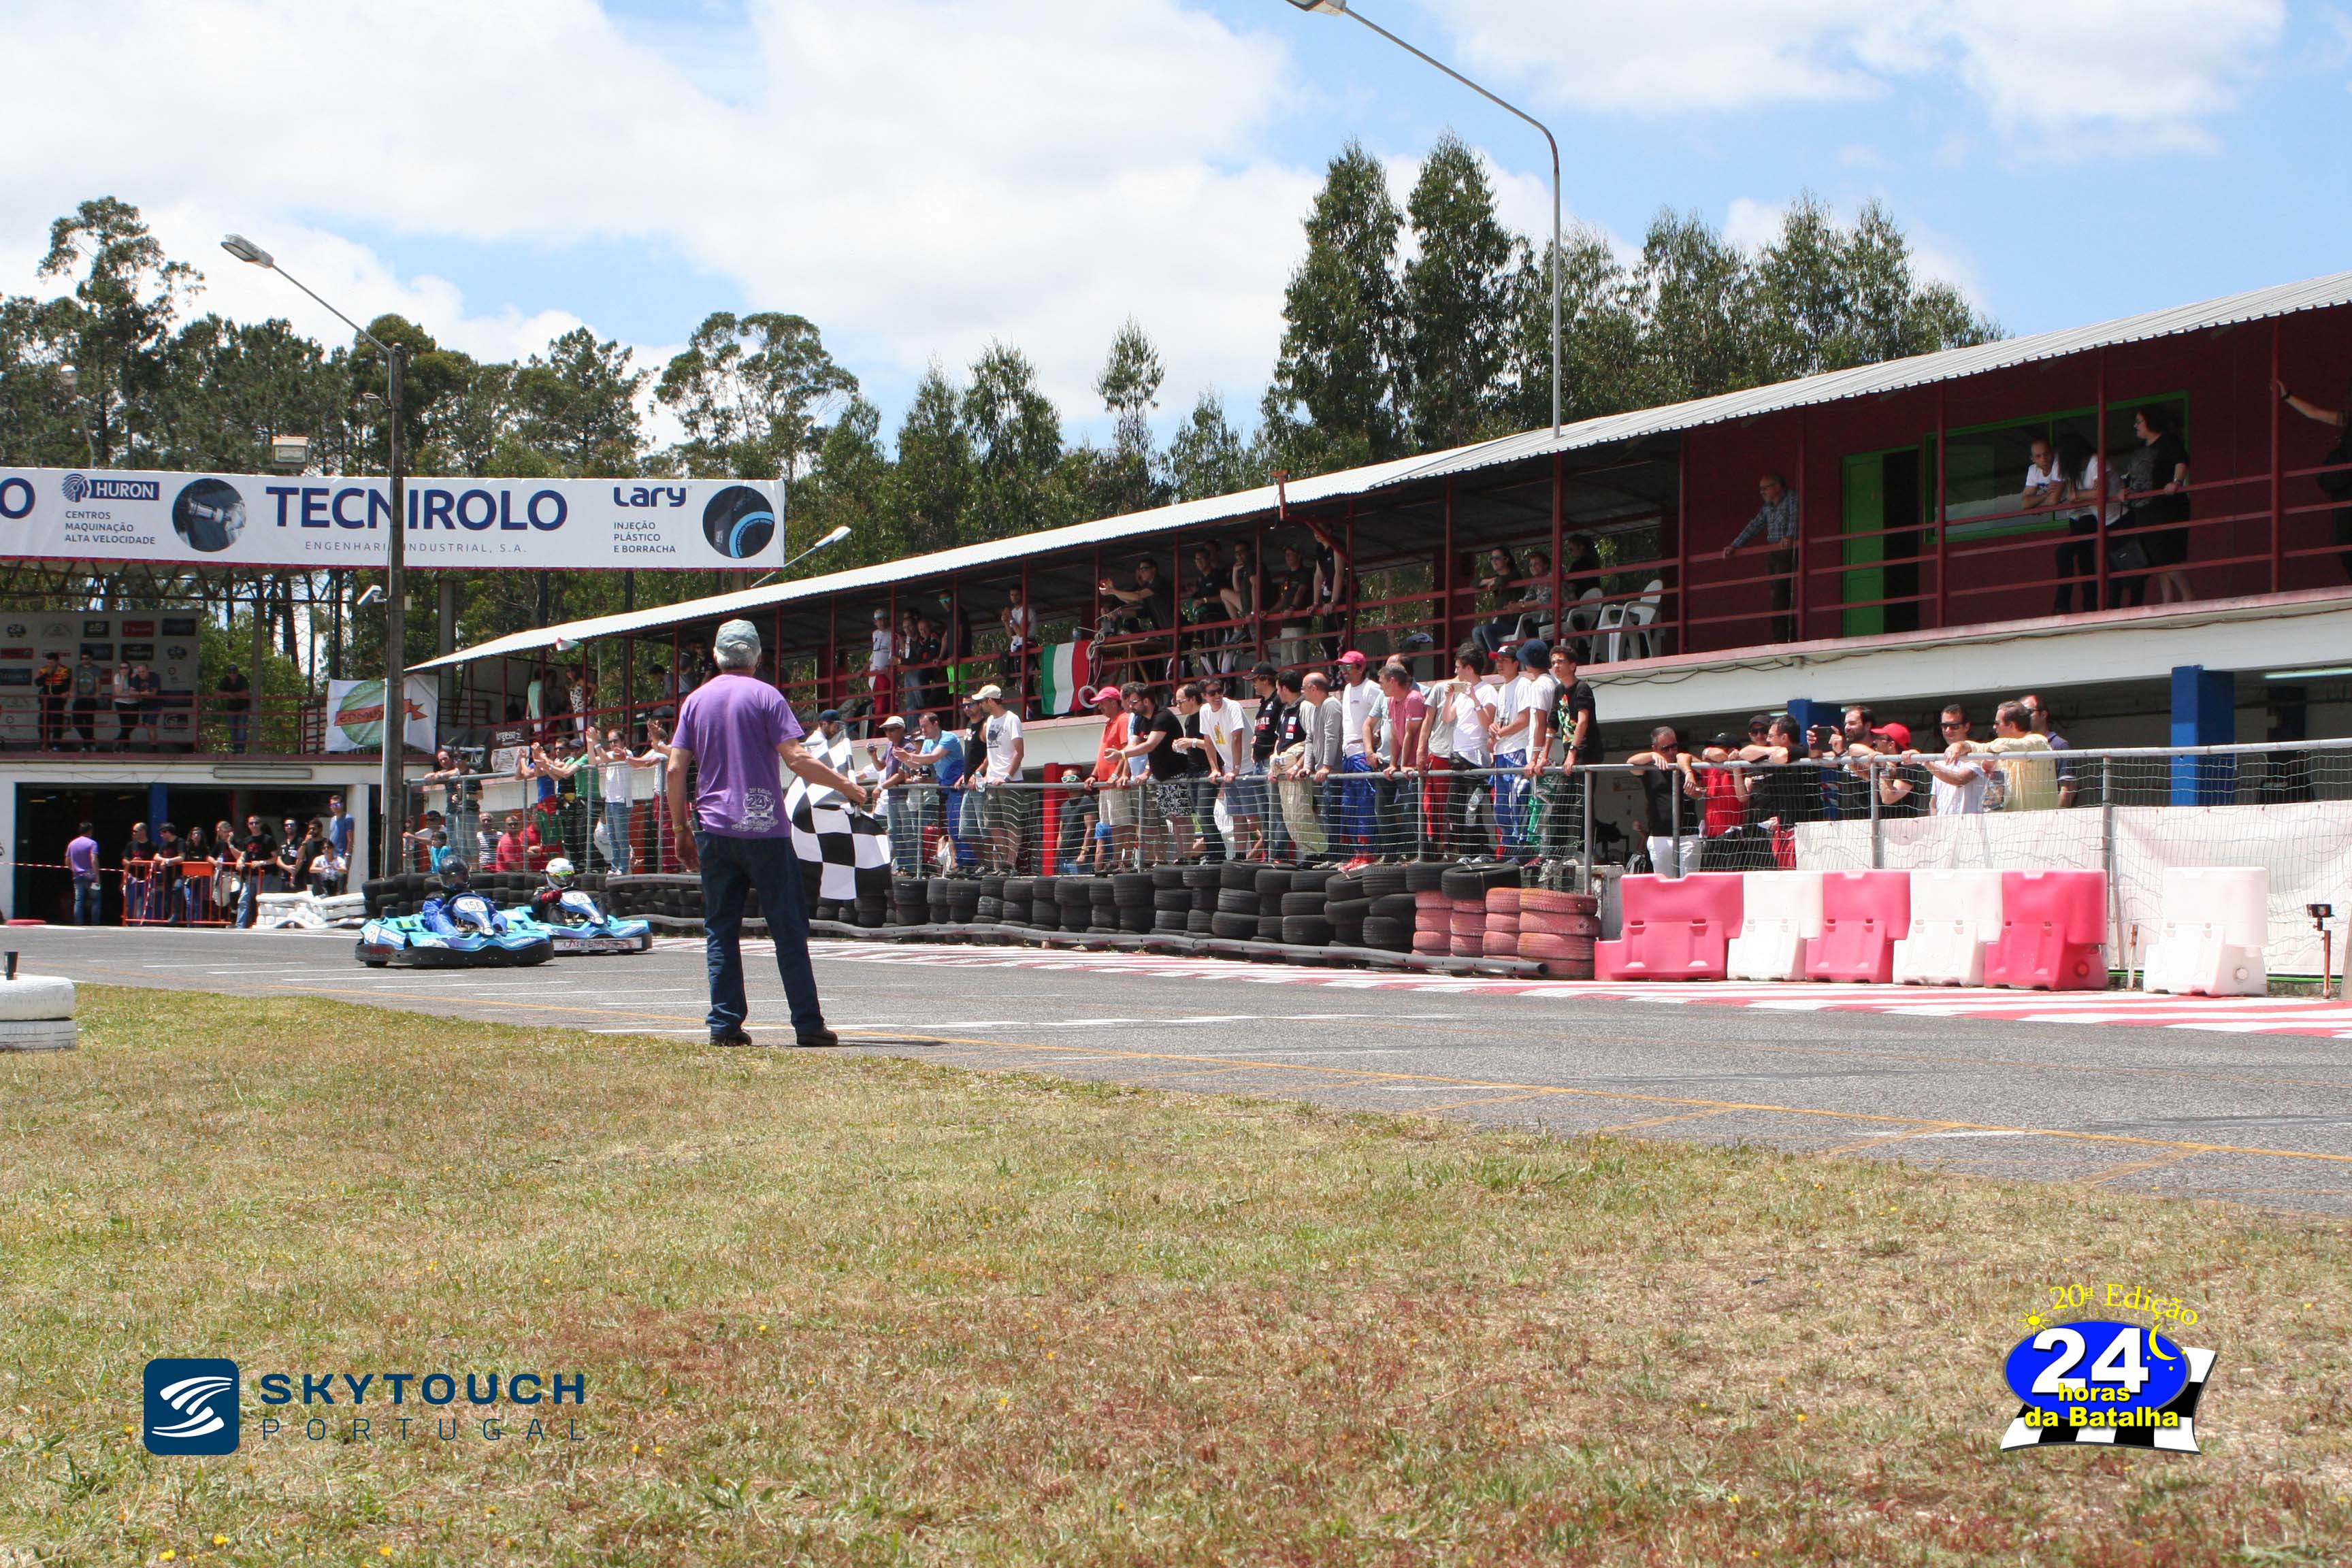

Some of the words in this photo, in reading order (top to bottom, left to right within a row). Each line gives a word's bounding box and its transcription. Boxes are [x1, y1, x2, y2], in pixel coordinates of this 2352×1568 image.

[96, 482, 154, 498] HURON
[266, 486, 568, 531] TECNIROLO
[65, 511, 111, 520] CENTROS
[65, 522, 134, 534] MAQUINAÇÃO
[614, 520, 656, 532] INJEÇÃO
[65, 534, 90, 542] ALTA
[93, 536, 156, 544] VELOCIDADE
[614, 531, 662, 542] PLÁSTICO
[305, 541, 386, 551] ENGENHARI
[500, 544, 527, 553] S.A.
[614, 545, 620, 553] E
[622, 545, 676, 553] BORRACHA
